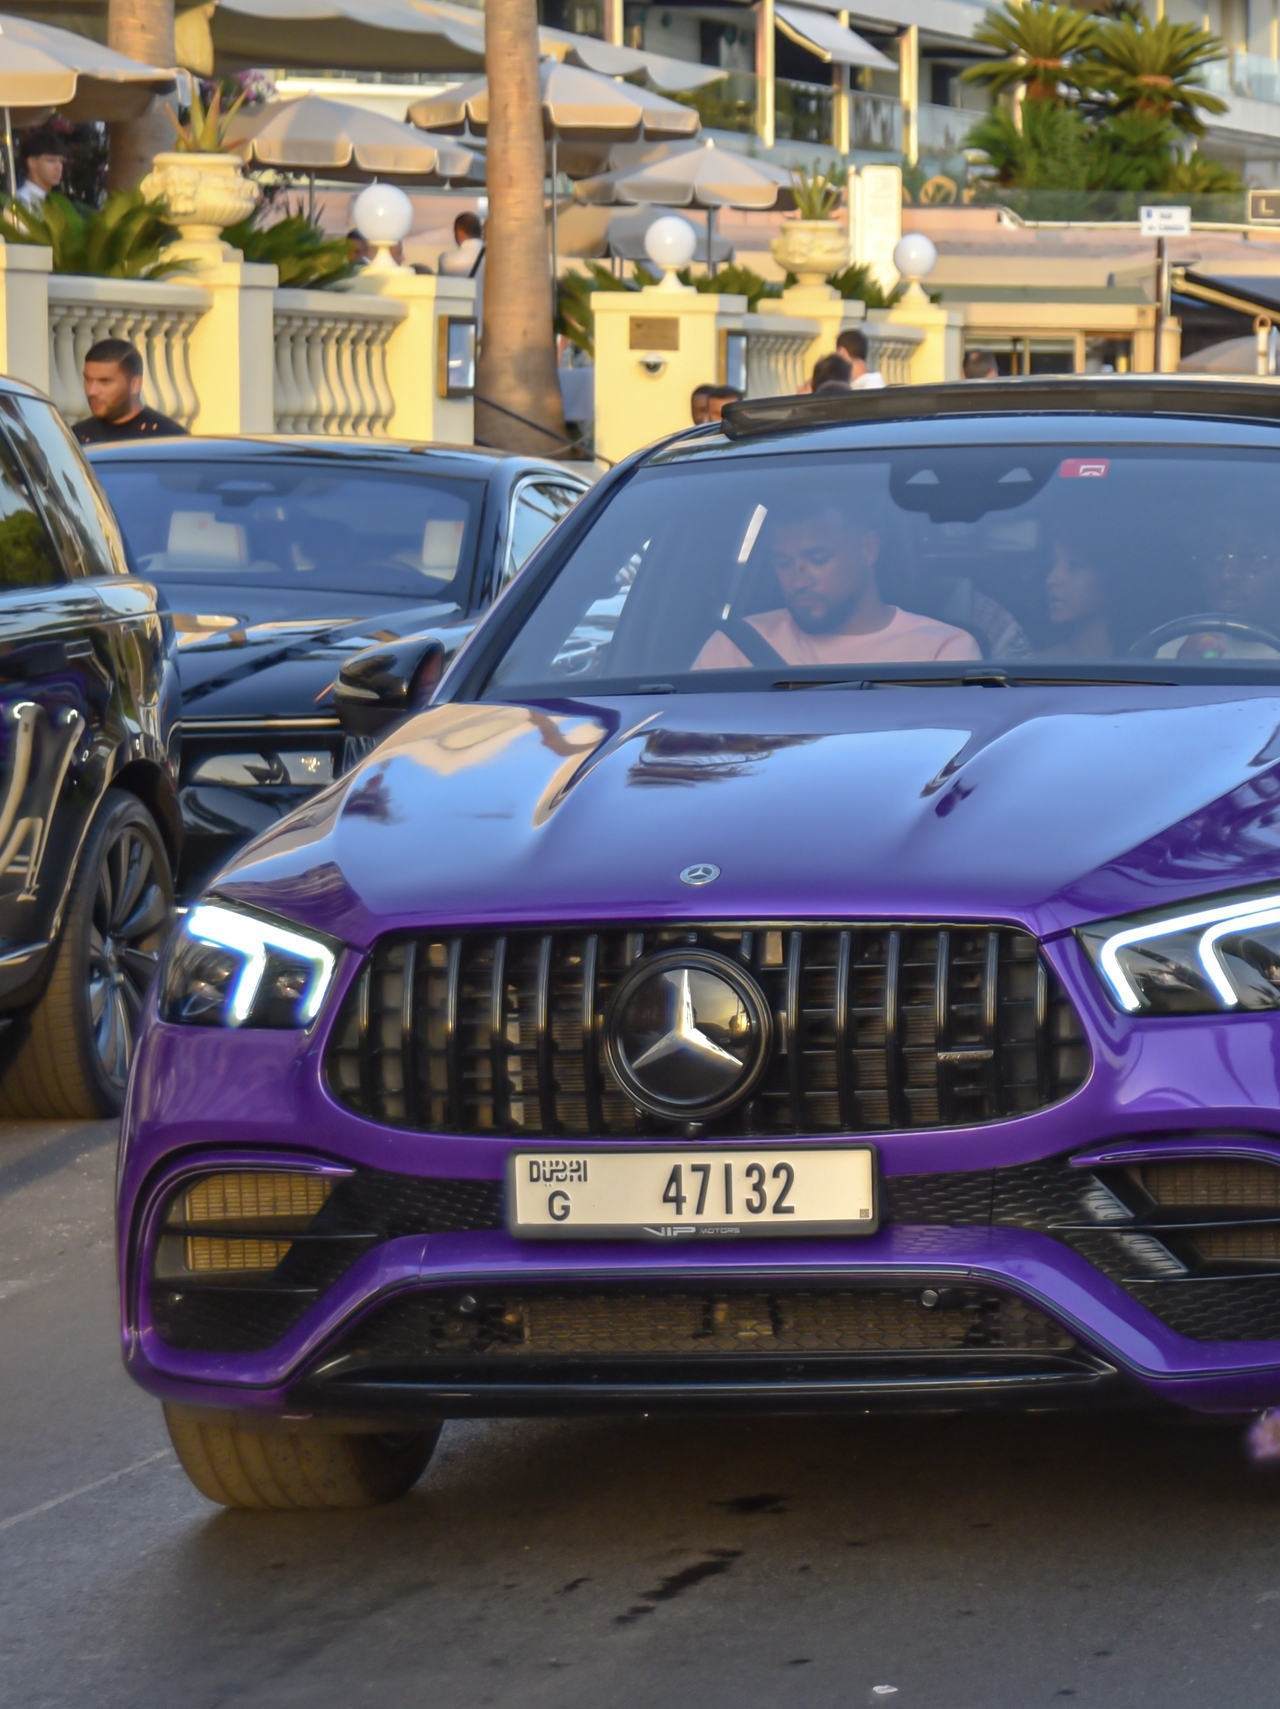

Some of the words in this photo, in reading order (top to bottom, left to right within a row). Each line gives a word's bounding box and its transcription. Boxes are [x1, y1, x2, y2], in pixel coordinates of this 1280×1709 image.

[548, 1190, 571, 1221] G
[662, 1162, 795, 1216] 47132
[643, 1226, 696, 1237] VIP
